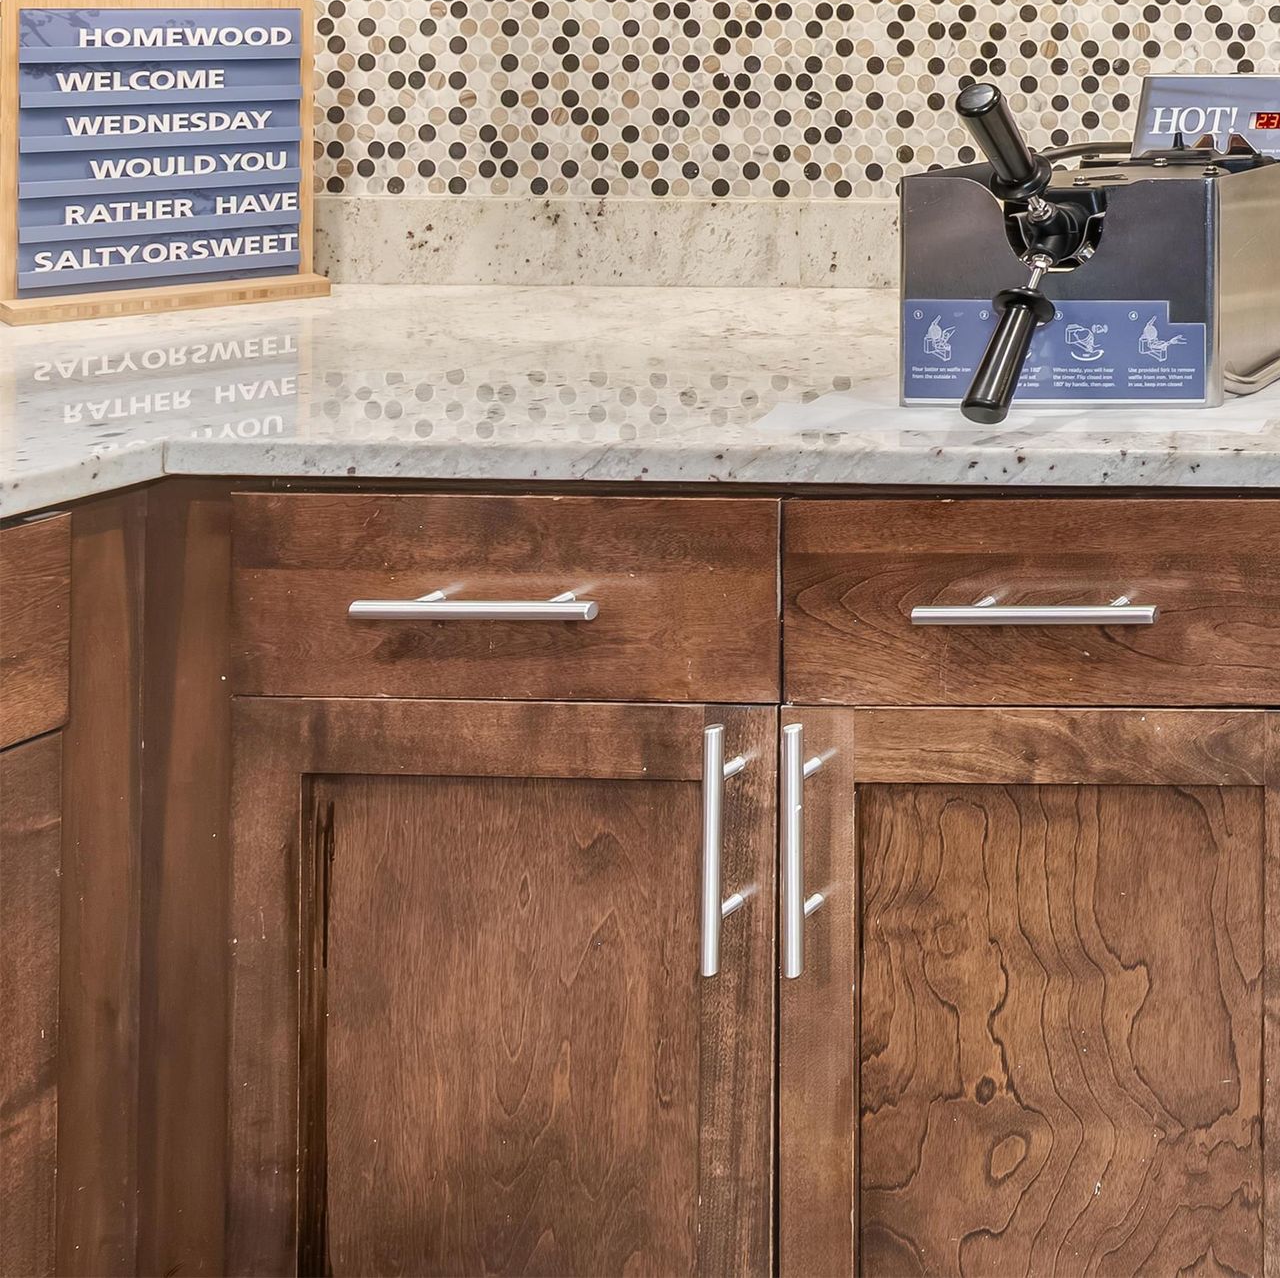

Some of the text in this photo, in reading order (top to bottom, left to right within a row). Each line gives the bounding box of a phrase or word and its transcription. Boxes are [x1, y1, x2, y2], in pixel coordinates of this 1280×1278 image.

[78, 27, 292, 48] HOMEWOOD
[56, 69, 225, 93] WELCOME
[65, 110, 273, 137] WEDNESDAY
[1148, 107, 1238, 134] HOT!
[64, 192, 298, 226] RATHER HAVE
